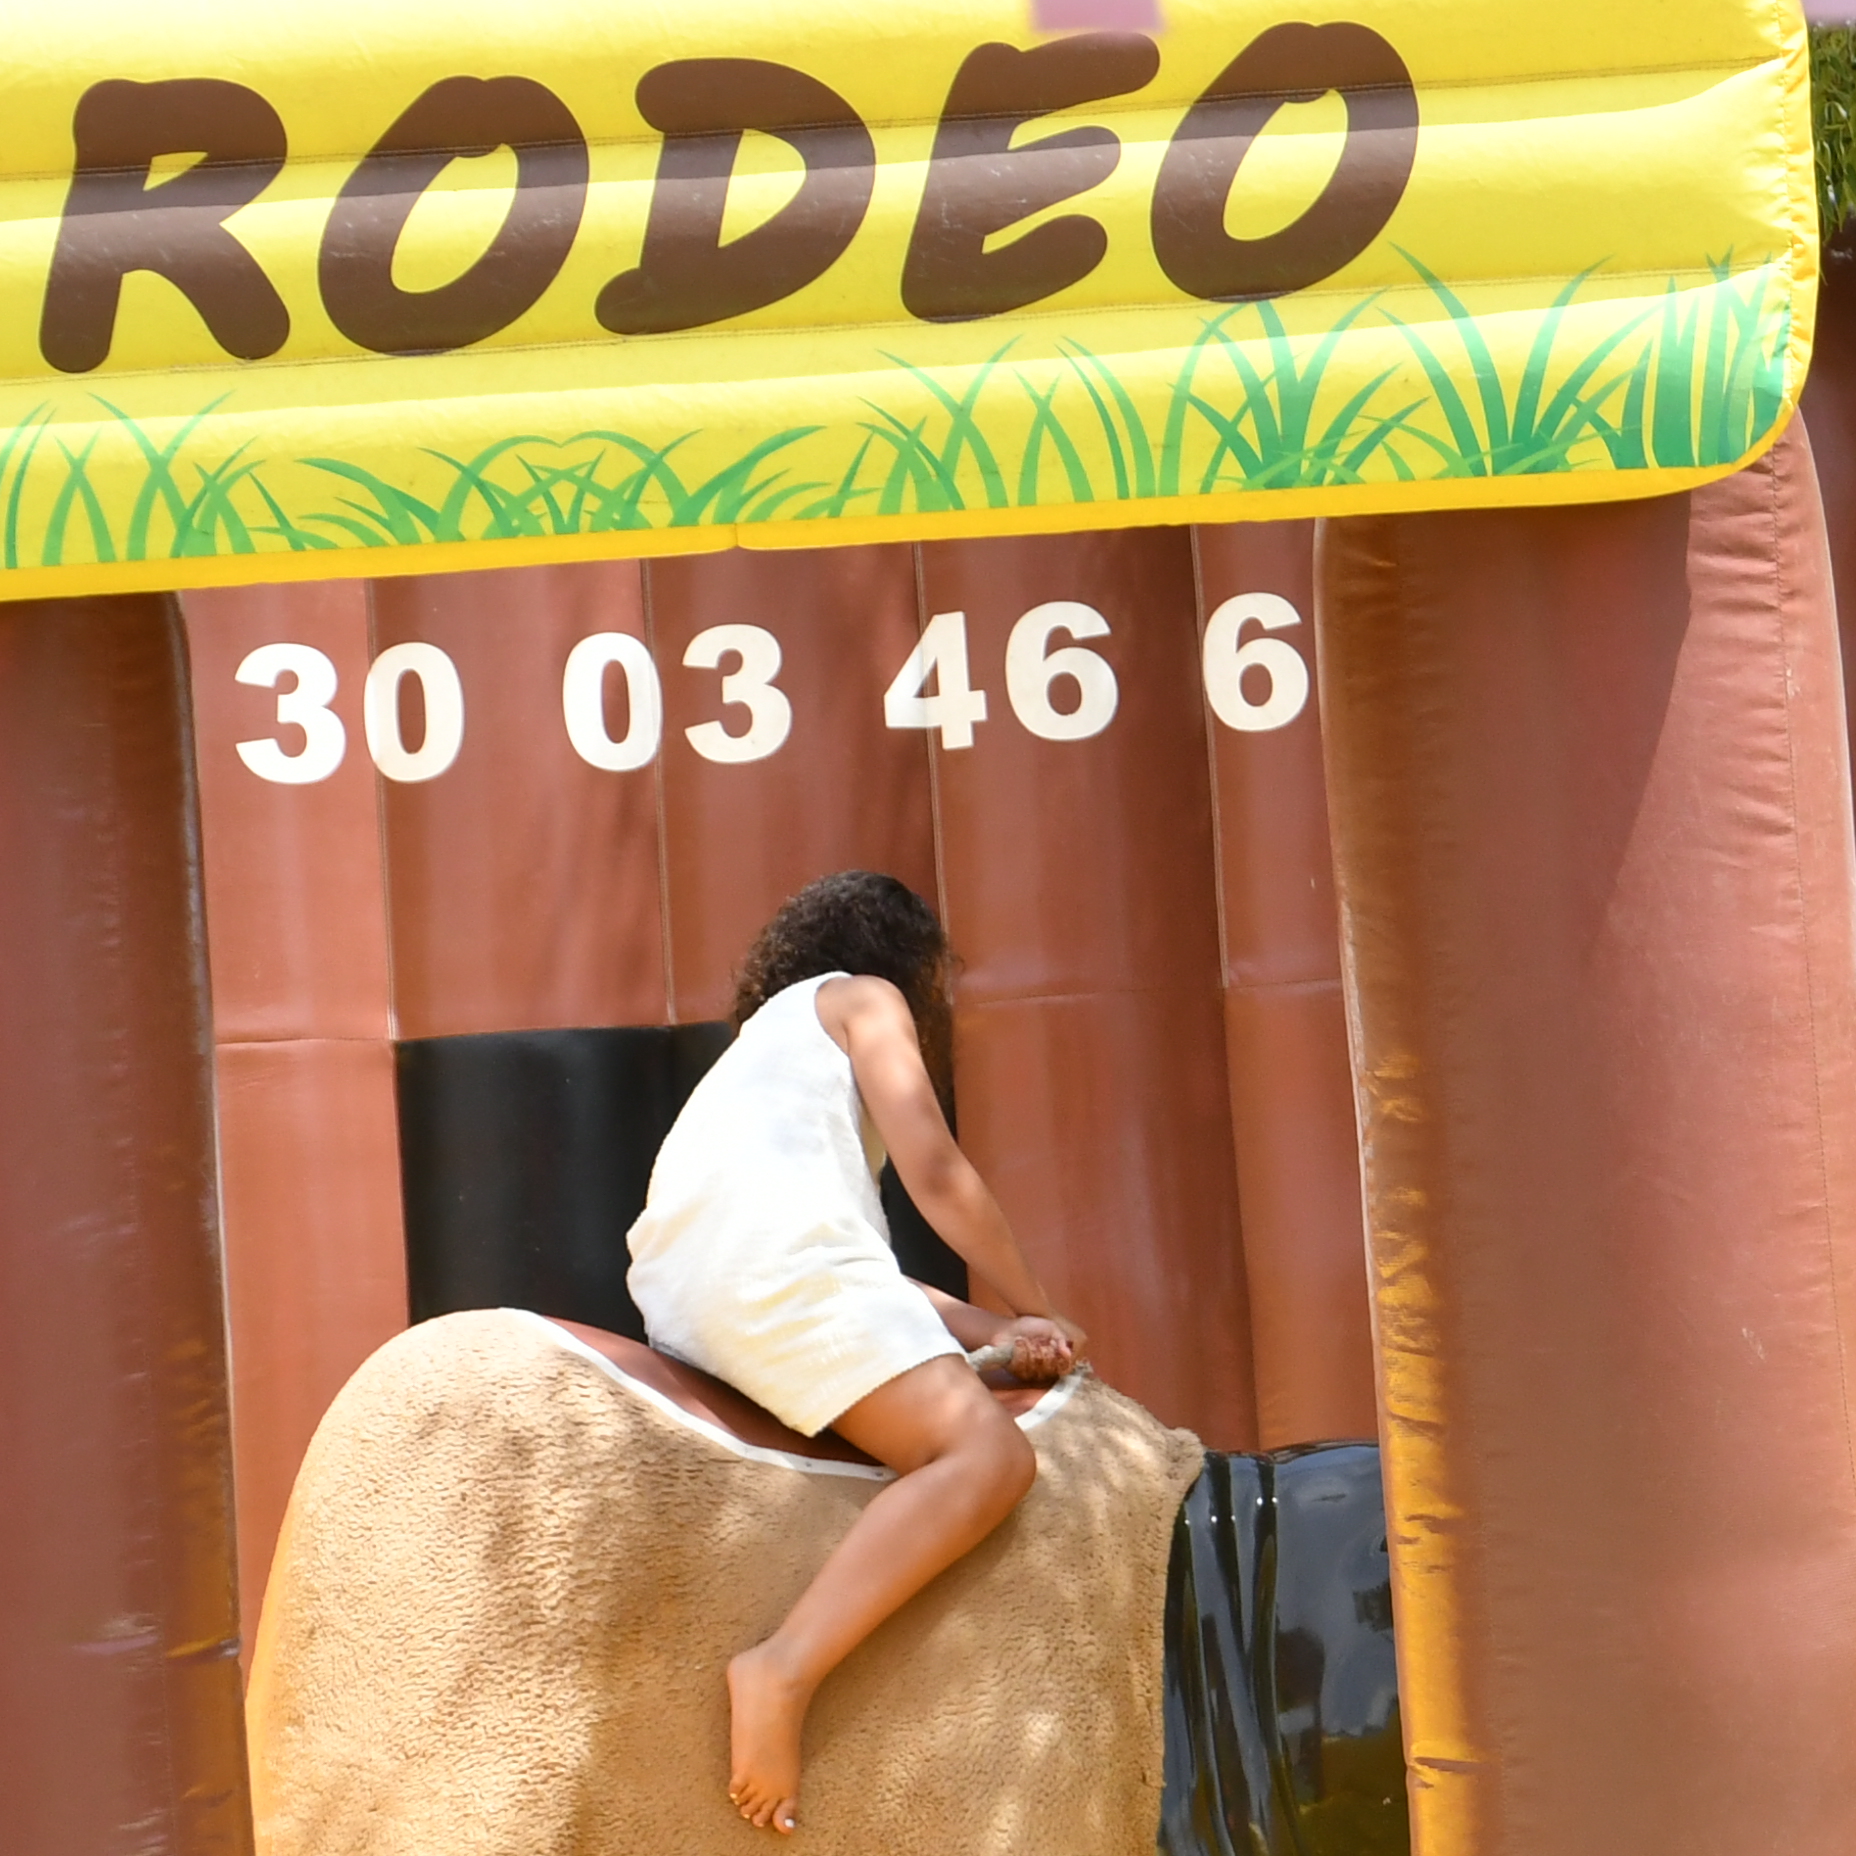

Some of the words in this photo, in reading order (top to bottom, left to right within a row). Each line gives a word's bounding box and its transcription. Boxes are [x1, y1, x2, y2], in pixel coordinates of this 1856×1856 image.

[36, 20, 1421, 373] RODEO
[233, 641, 465, 784] 30
[561, 623, 794, 772] 03
[882, 599, 1119, 751] 46
